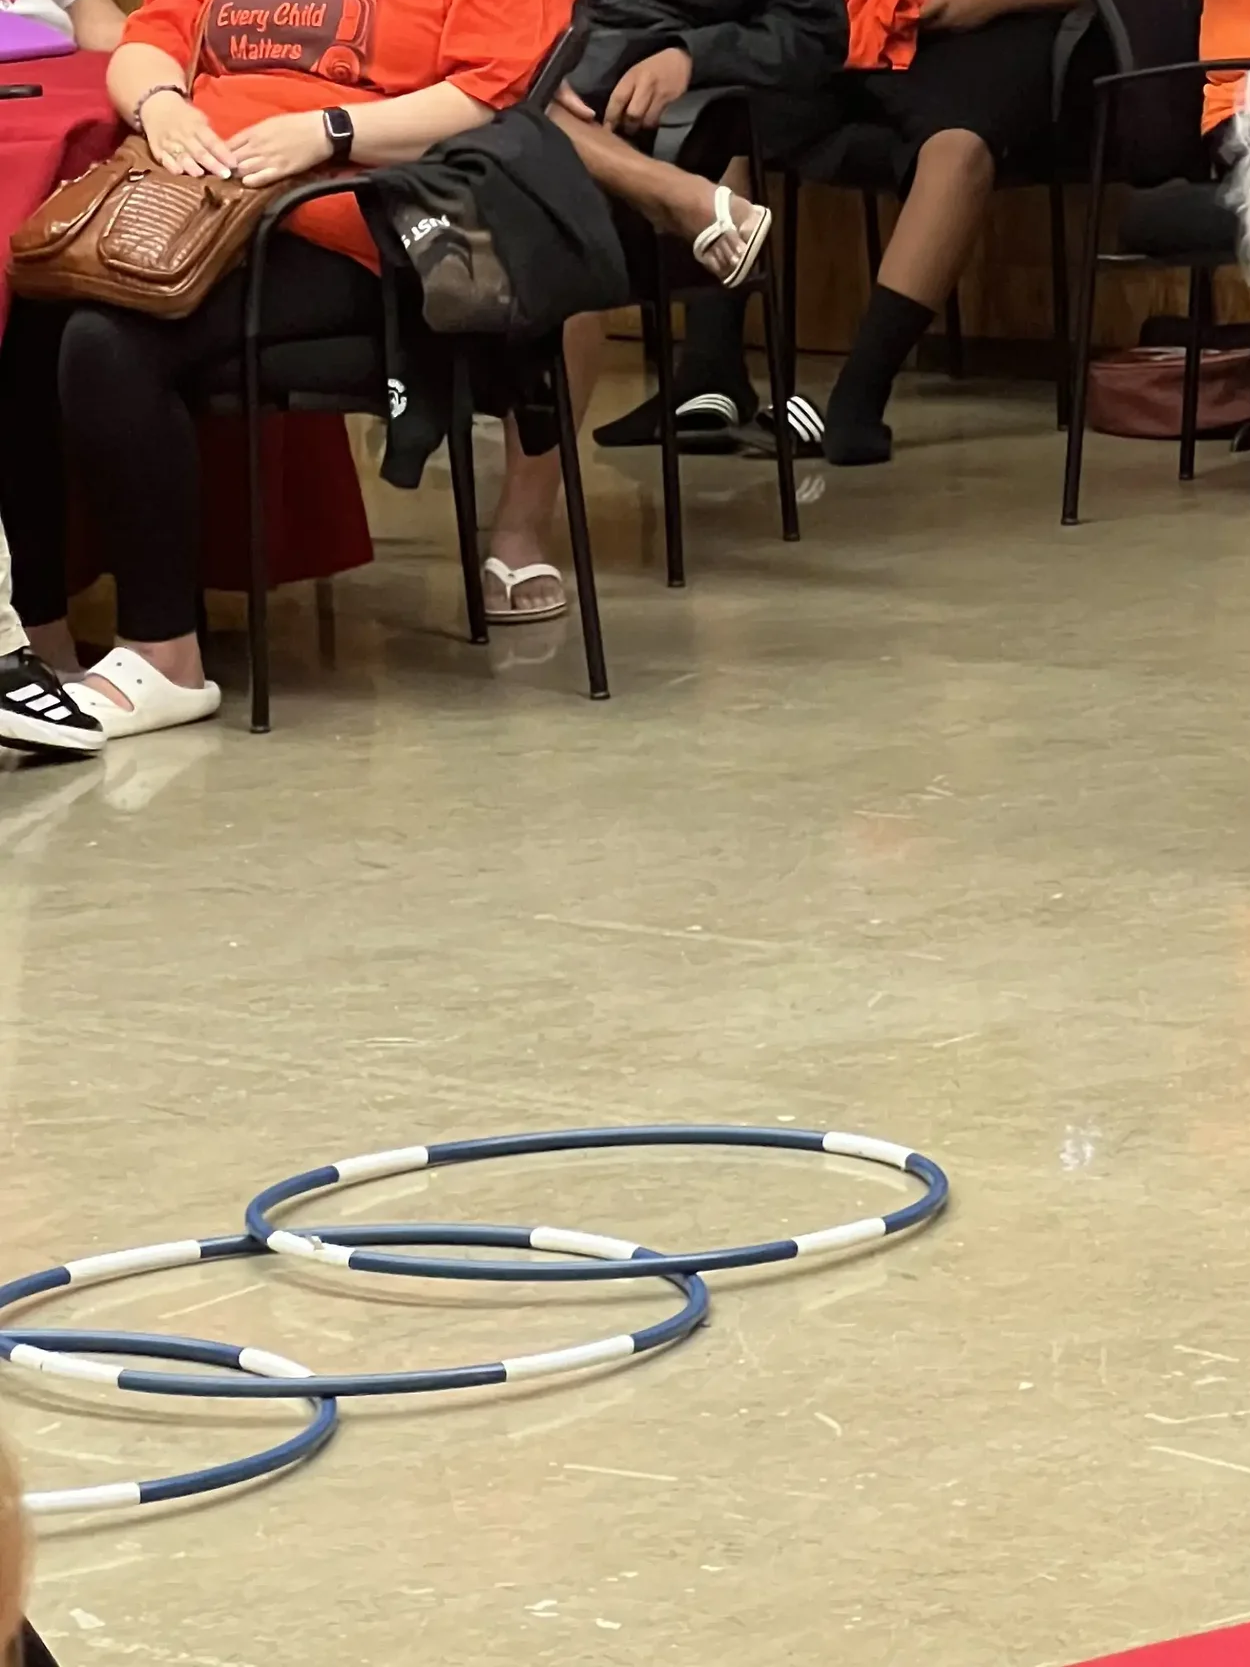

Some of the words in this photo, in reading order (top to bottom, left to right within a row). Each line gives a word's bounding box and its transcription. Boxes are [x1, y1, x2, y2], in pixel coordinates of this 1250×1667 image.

[217, 1, 270, 32] Every
[273, 2, 326, 28] Child
[230, 34, 302, 60] Matters
